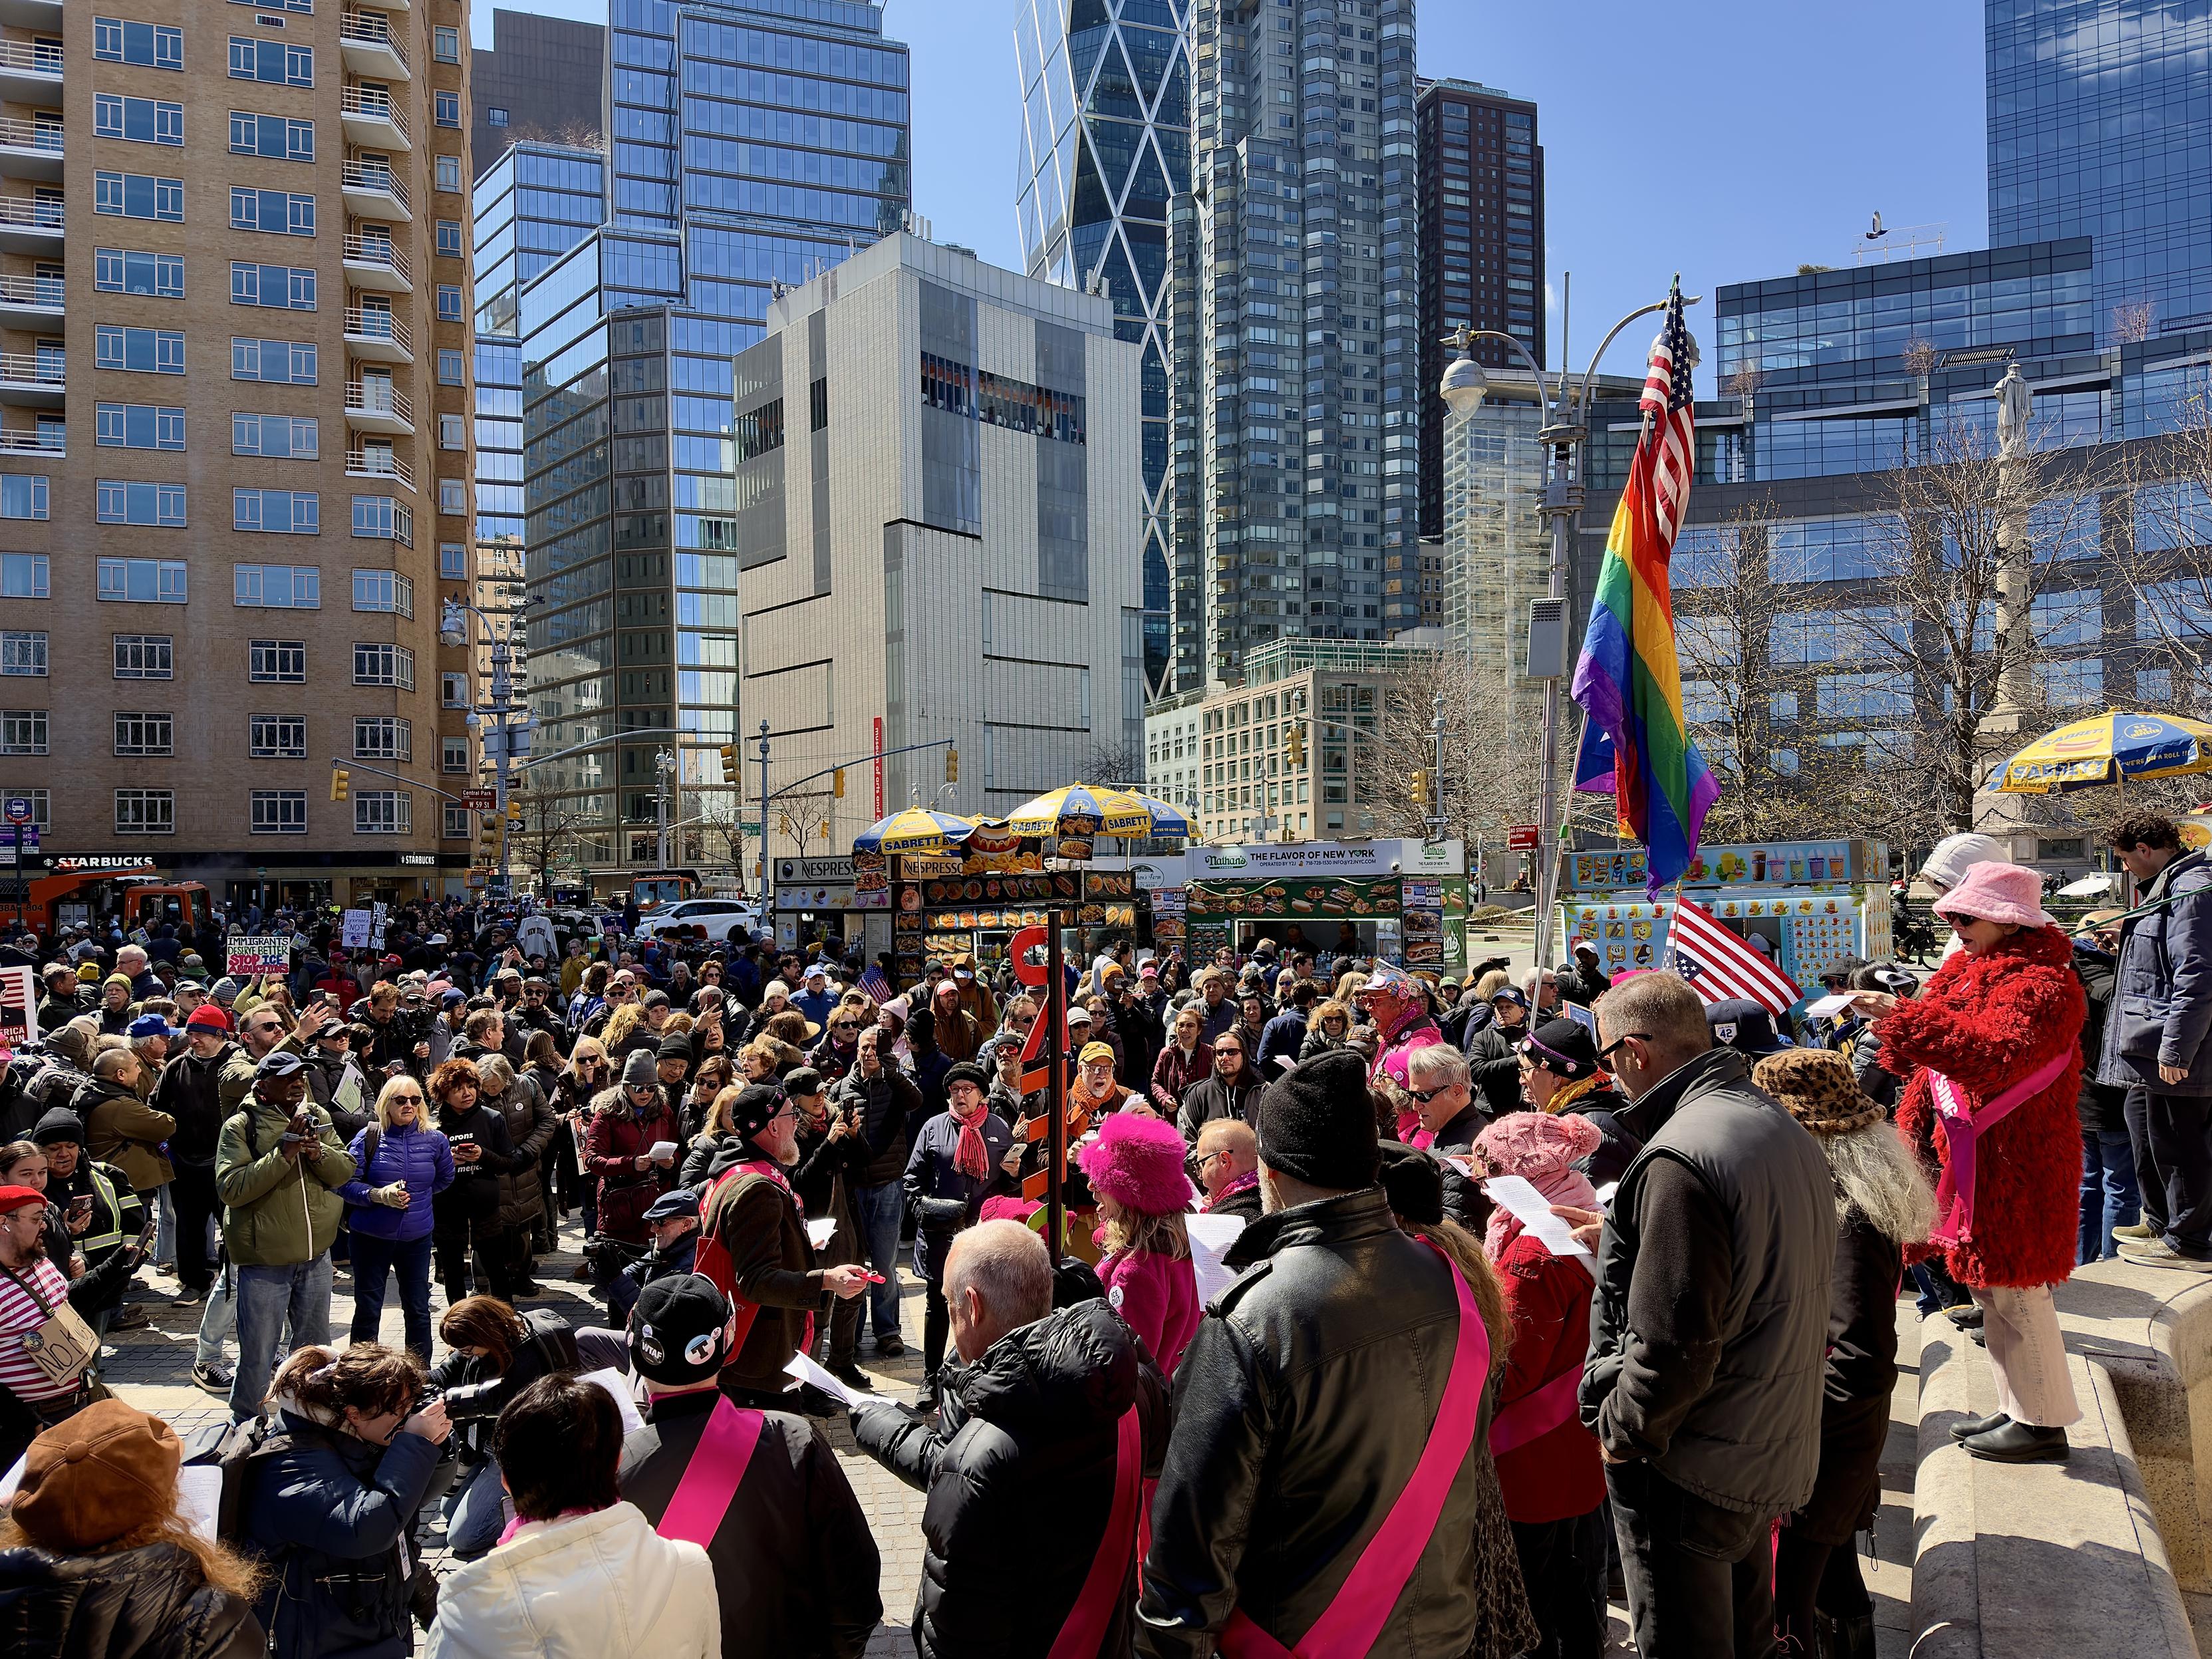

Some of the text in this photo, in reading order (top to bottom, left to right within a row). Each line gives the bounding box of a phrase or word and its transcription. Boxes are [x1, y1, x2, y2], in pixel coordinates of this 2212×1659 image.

[2040, 728, 2107, 748] SABRETT
[2012, 760, 2106, 779] SABRETT
[893, 819, 929, 831] SABRETT
[1012, 820, 1053, 832] SABRETT
[1108, 816, 1148, 829] SABRETT
[885, 836, 940, 851] SABRETT
[1270, 851, 1305, 860] FLAVOR
[1421, 844, 1447, 856] Nathan's
[58, 856, 153, 867] STARBUCKS
[405, 855, 435, 865] STARBUCKS
[1205, 855, 1248, 866] Nathan's
[799, 860, 854, 879] NESPRES
[1425, 886, 1441, 896] CASH
[374, 901, 388, 914] DROP
[372, 913, 387, 926] FILES
[374, 925, 385, 938] NOT
[77, 940, 91, 951] KOREA
[228, 937, 289, 946] IMMIGRANTS
[370, 936, 386, 951] BOMBS
[228, 946, 289, 955] DESERVE BETTER
[229, 954, 283, 965] STOP ICE
[227, 963, 289, 975] ABDUCTIONS
[1720, 1028, 1733, 1038] 42
[449, 1132, 474, 1141] orons
[1111, 1296, 1121, 1306] OUT
[35, 1317, 93, 1376] NO KINGS
[642, 1341, 663, 1360] WTAF
[690, 1339, 708, 1360] T
